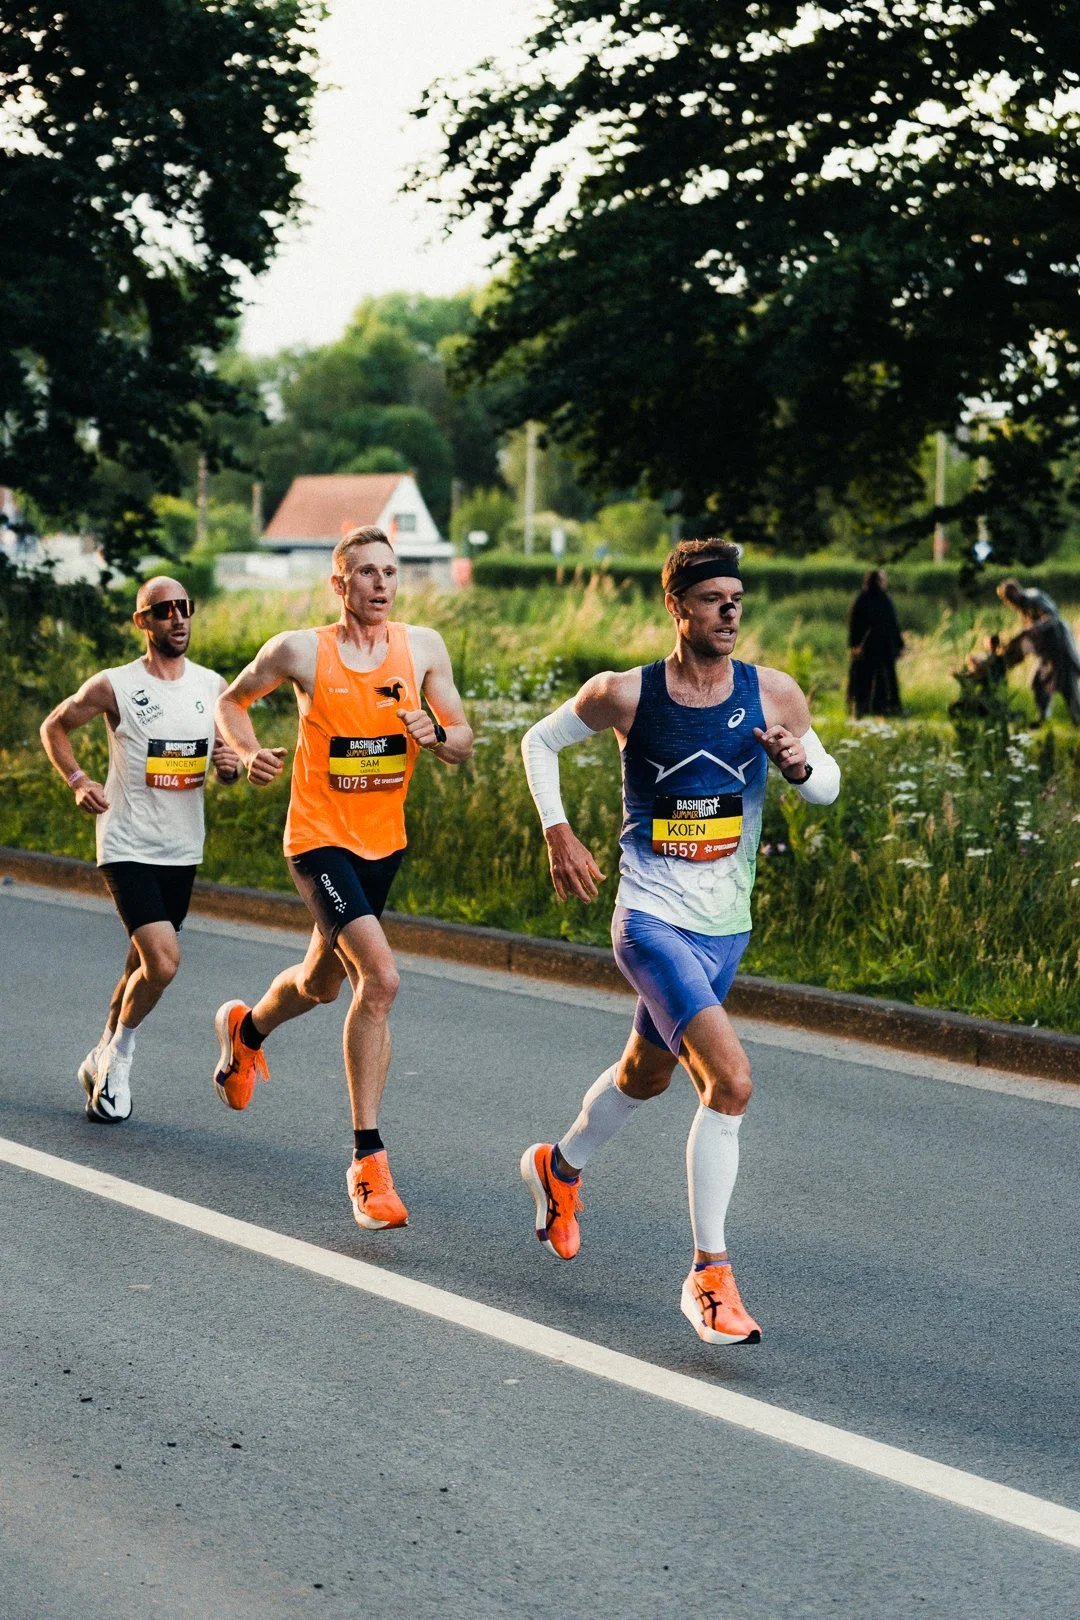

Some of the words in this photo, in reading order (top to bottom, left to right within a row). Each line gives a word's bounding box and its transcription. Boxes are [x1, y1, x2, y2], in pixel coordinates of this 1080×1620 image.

[136, 704, 160, 719] SLOW
[165, 760, 197, 768] VINCENT
[360, 759, 380, 768] SAM
[153, 774, 179, 787] 1104
[337, 776, 368, 789] 1075
[672, 810, 699, 819] SUMMER
[667, 821, 706, 837] KOEN
[661, 842, 699, 858] 1559
[320, 873, 343, 904] CRAFT
